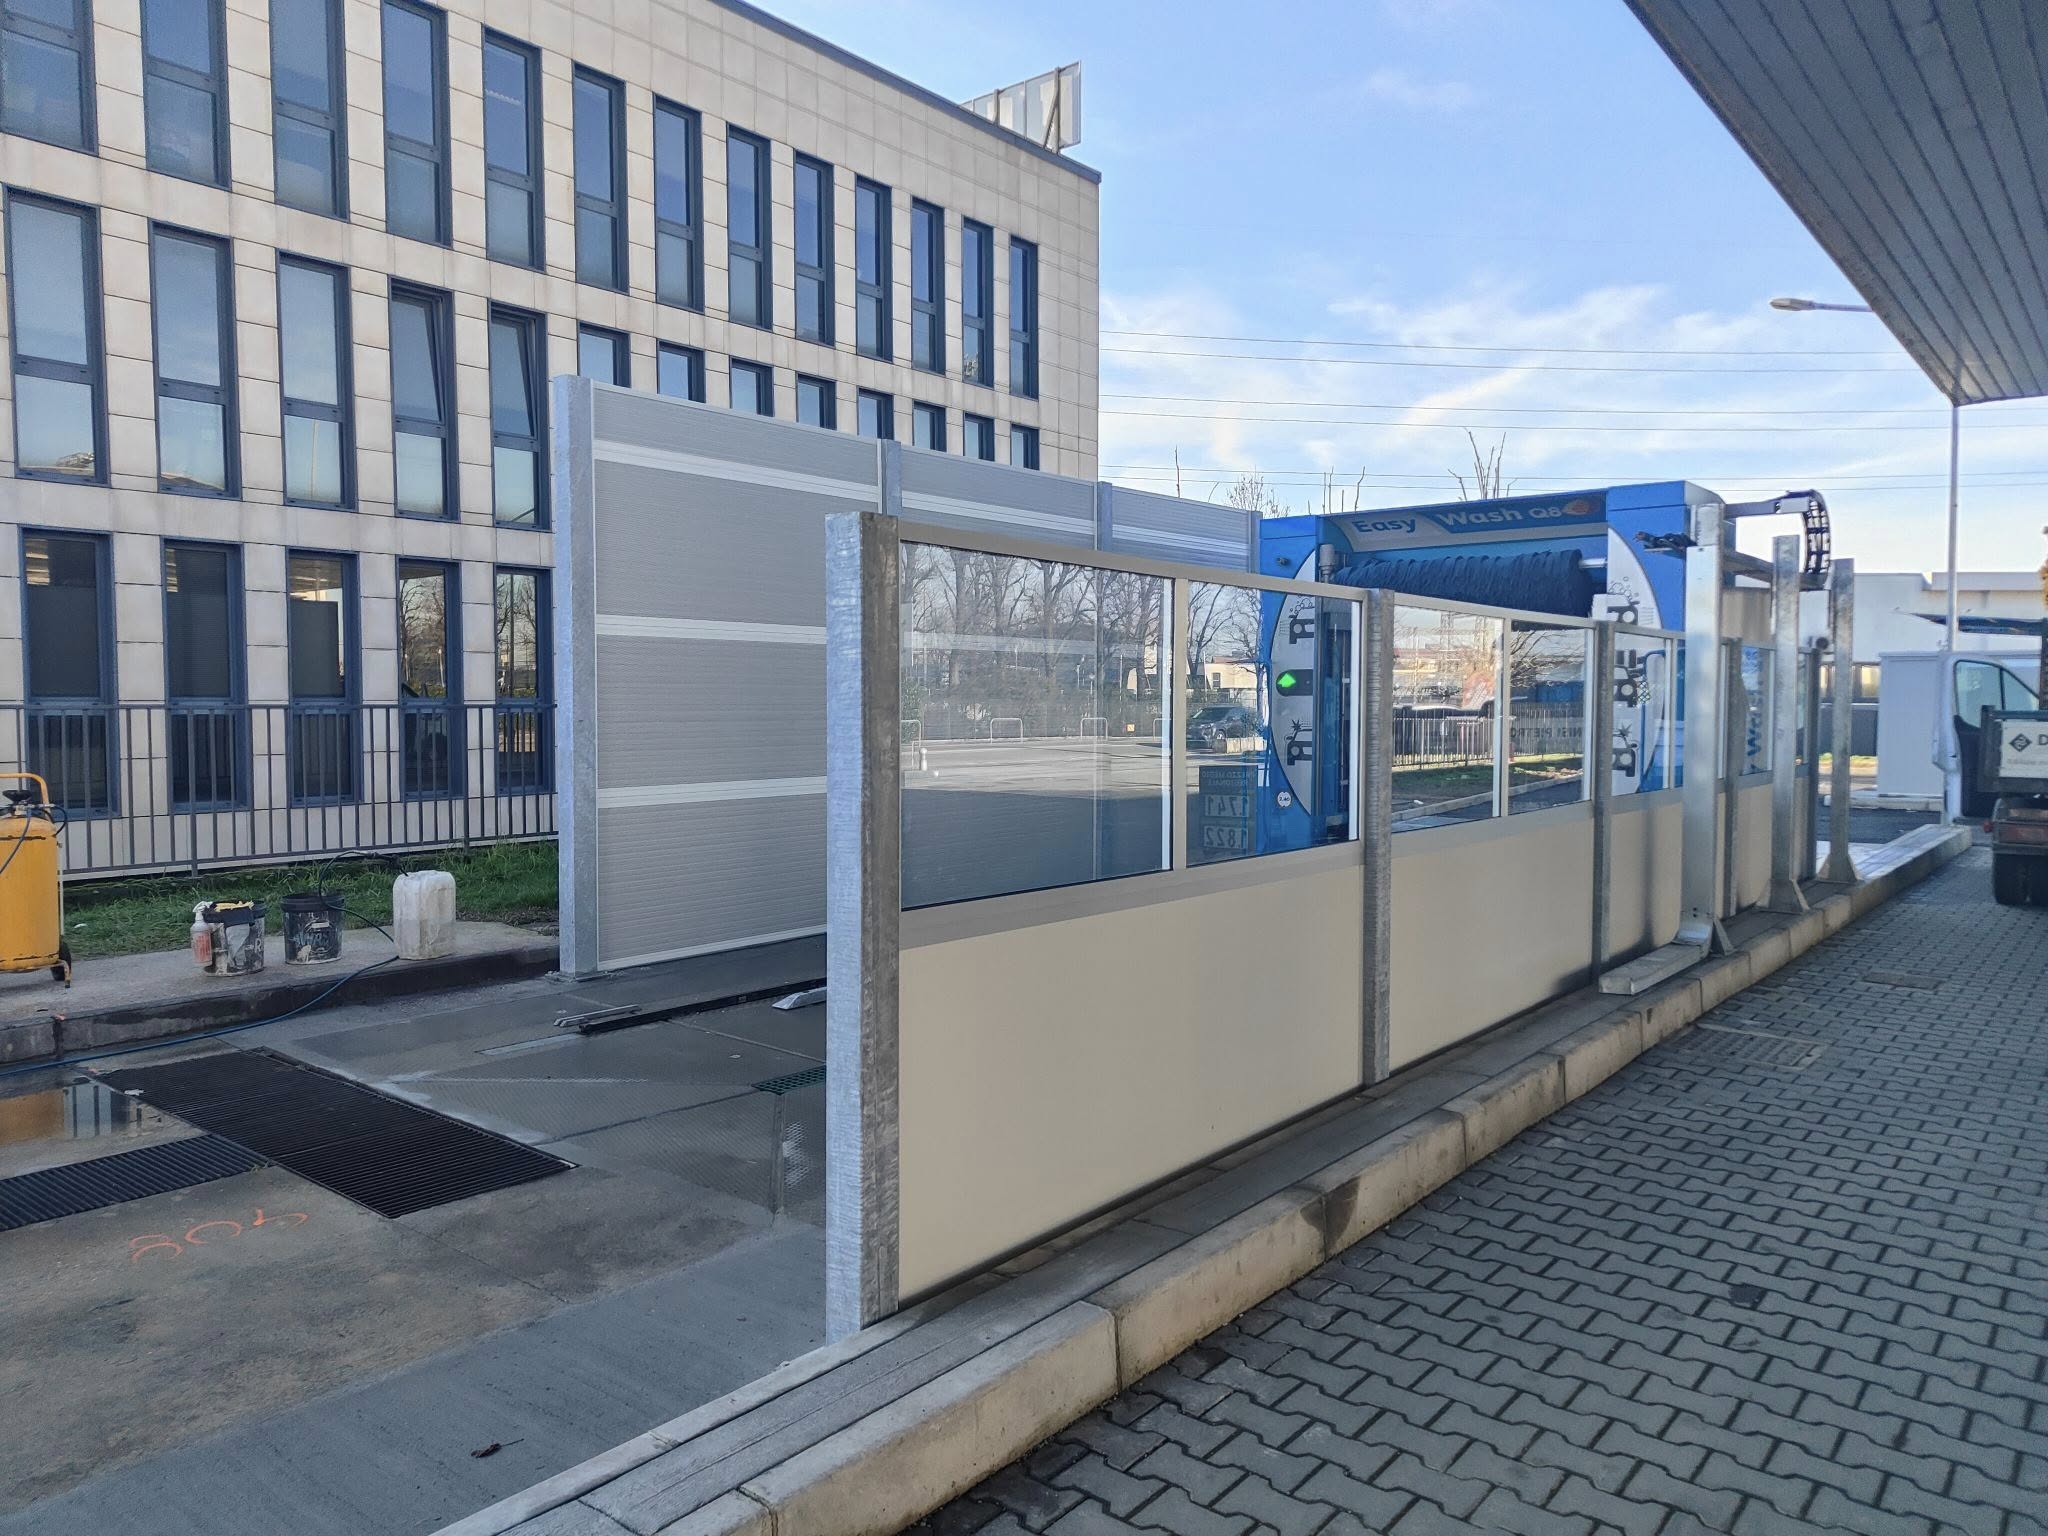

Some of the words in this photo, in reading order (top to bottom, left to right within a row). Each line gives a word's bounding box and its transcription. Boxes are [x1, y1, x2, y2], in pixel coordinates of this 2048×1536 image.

[1352, 517, 1416, 533] Easy
[1437, 505, 1522, 526] Wash
[1528, 506, 1562, 519] Q8
